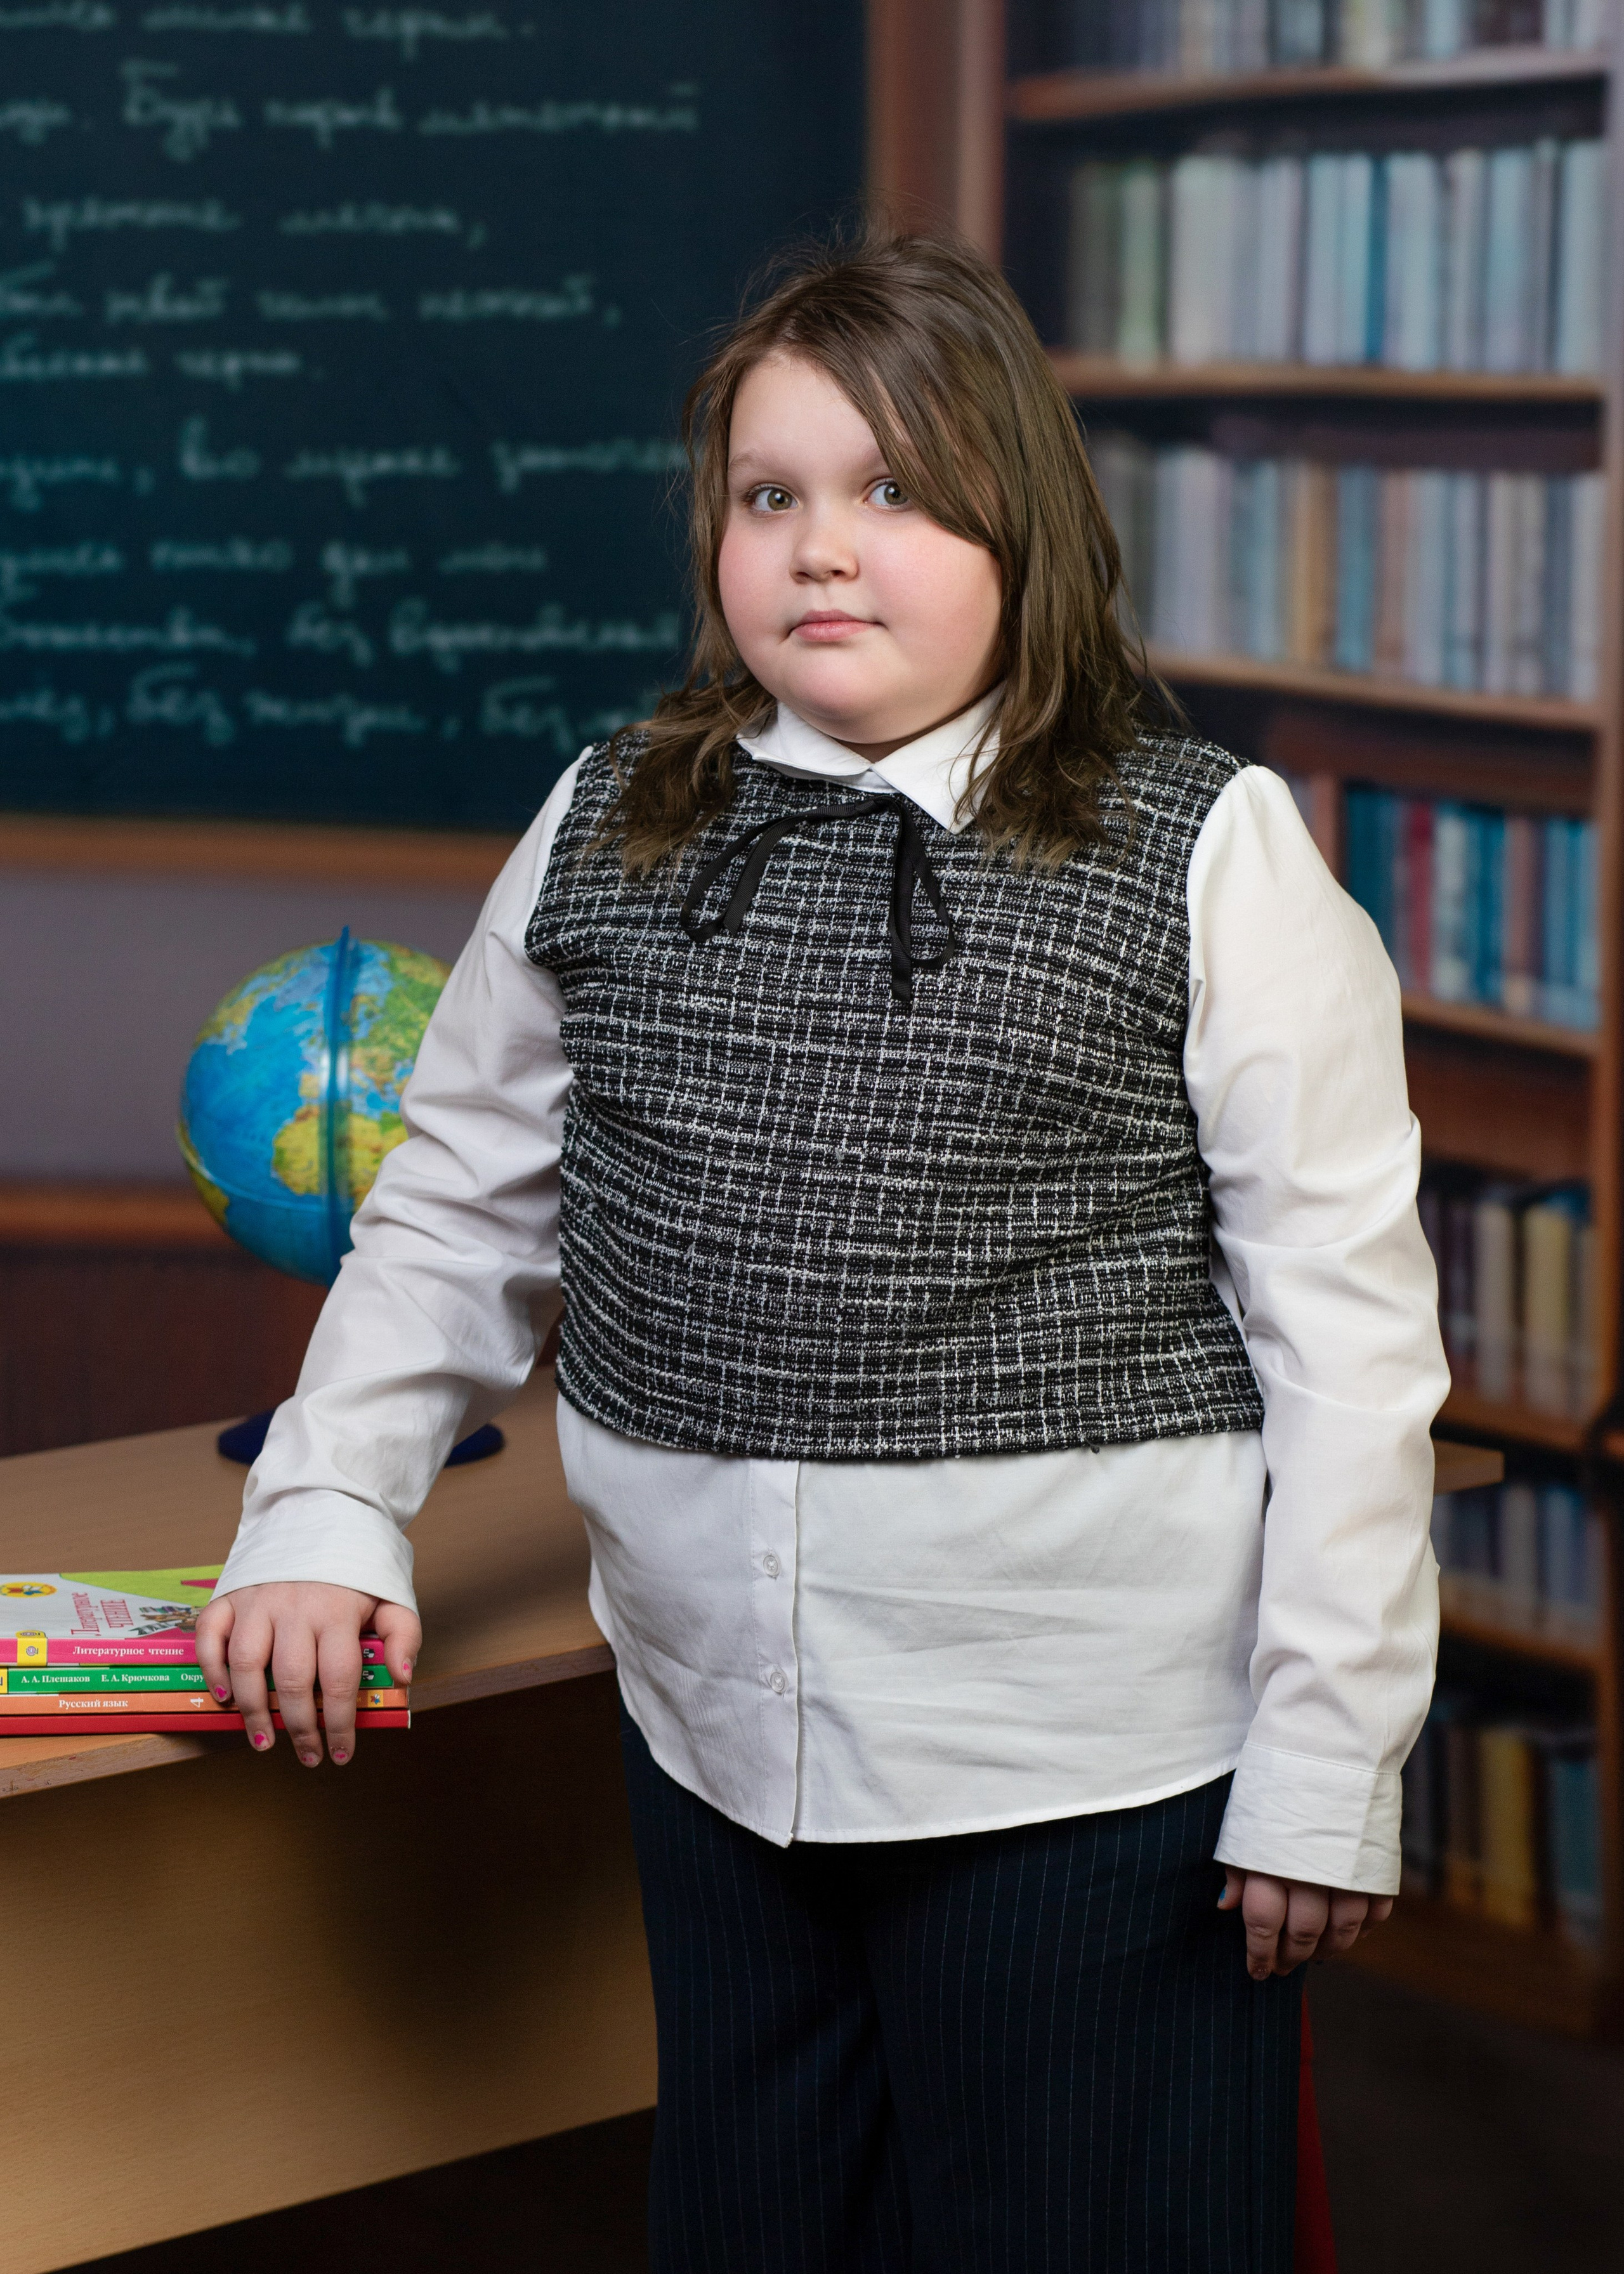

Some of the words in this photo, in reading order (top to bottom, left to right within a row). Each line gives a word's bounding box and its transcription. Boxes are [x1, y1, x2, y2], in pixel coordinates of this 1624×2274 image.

[72, 1646, 145, 1656] Литературное
[121, 1674, 169, 1683] Крючкова
[59, 1699, 102, 1709] Русский
[190, 1697, 204, 1708] 4
